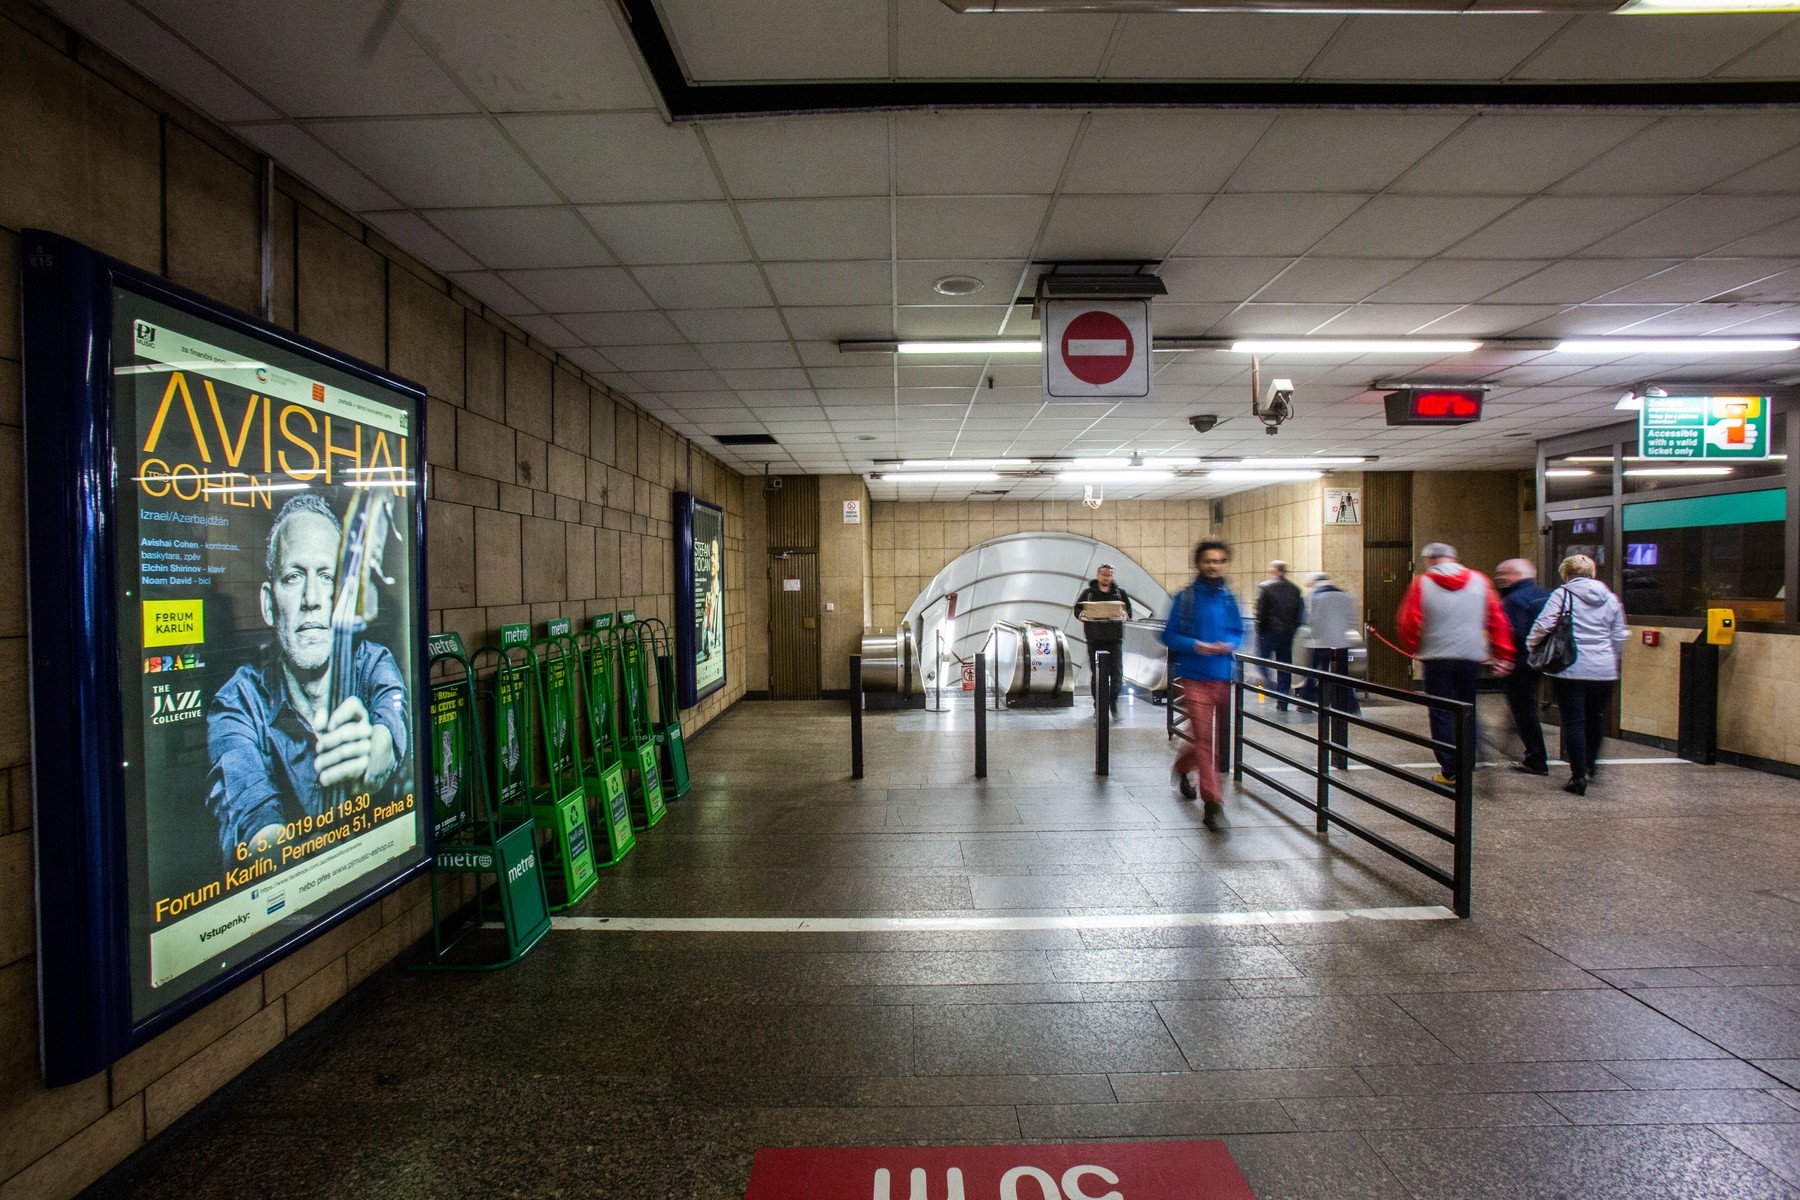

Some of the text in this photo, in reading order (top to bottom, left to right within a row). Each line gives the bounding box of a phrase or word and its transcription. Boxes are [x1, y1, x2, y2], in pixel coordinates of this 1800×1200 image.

[136, 338, 155, 348] MUSIC
[1648, 429, 1699, 438] Accessible
[1648, 438, 1668, 446] with
[1676, 438, 1698, 446] valid
[1648, 447, 1694, 456] ticket only
[140, 458, 272, 509] COHEN
[140, 508, 229, 527] Izrael/Azerbajdžán
[140, 538, 172, 547] Avishai
[174, 540, 199, 549] Cohen
[141, 551, 182, 561] baskytara,
[141, 564, 168, 572] Elchin
[170, 564, 202, 572] Shirinov
[156, 612, 193, 622] FORUM
[156, 622, 194, 634] KARLÍN
[505, 626, 528, 644] metro
[551, 622, 569, 636] metro
[144, 652, 206, 674] ISRAEL
[152, 685, 171, 694] THE
[150, 689, 202, 718] JAZZ
[153, 709, 202, 725] COLLECTIVE
[236, 792, 370, 861] 6. 5. 2019 od 19.30
[154, 793, 414, 923] Forum Karlín, Pernerova 51, Praha 8
[437, 852, 492, 868] metro
[508, 851, 535, 884] metro
[199, 912, 251, 943] Vstupenky:
[298, 879, 316, 894] nebo
[317, 871, 332, 886] přes
